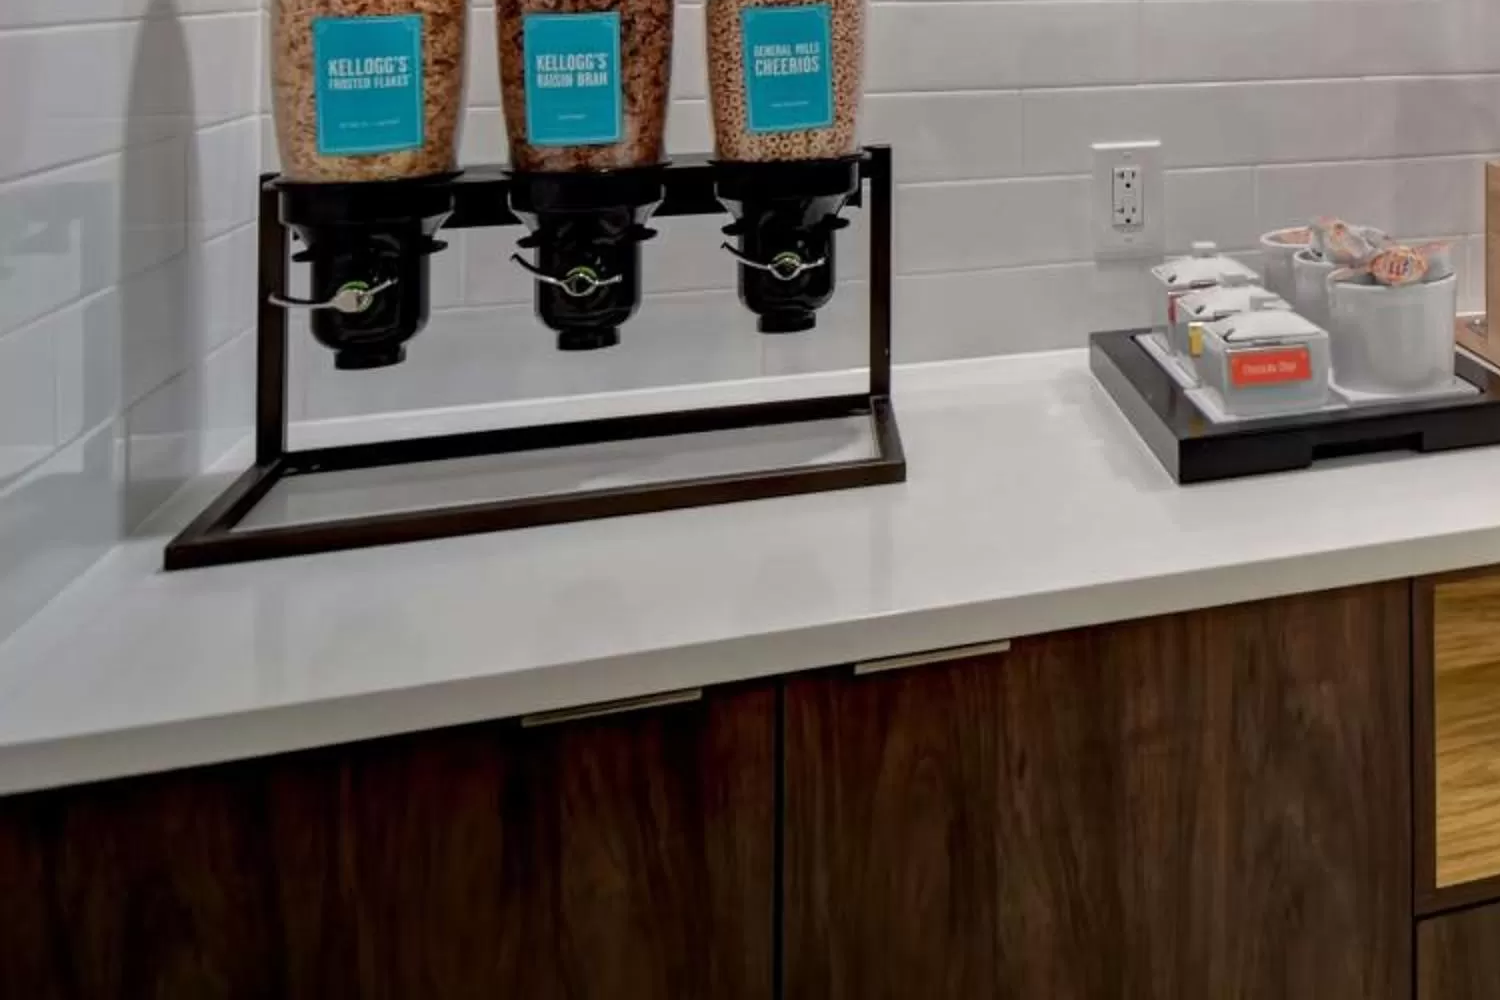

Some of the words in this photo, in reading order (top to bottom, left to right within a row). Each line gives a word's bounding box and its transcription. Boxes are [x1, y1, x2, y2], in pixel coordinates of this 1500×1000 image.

[327, 55, 411, 77] KELLOGG'S
[537, 52, 609, 72] KELLOGG'S
[755, 55, 820, 77] CHEERIOS
